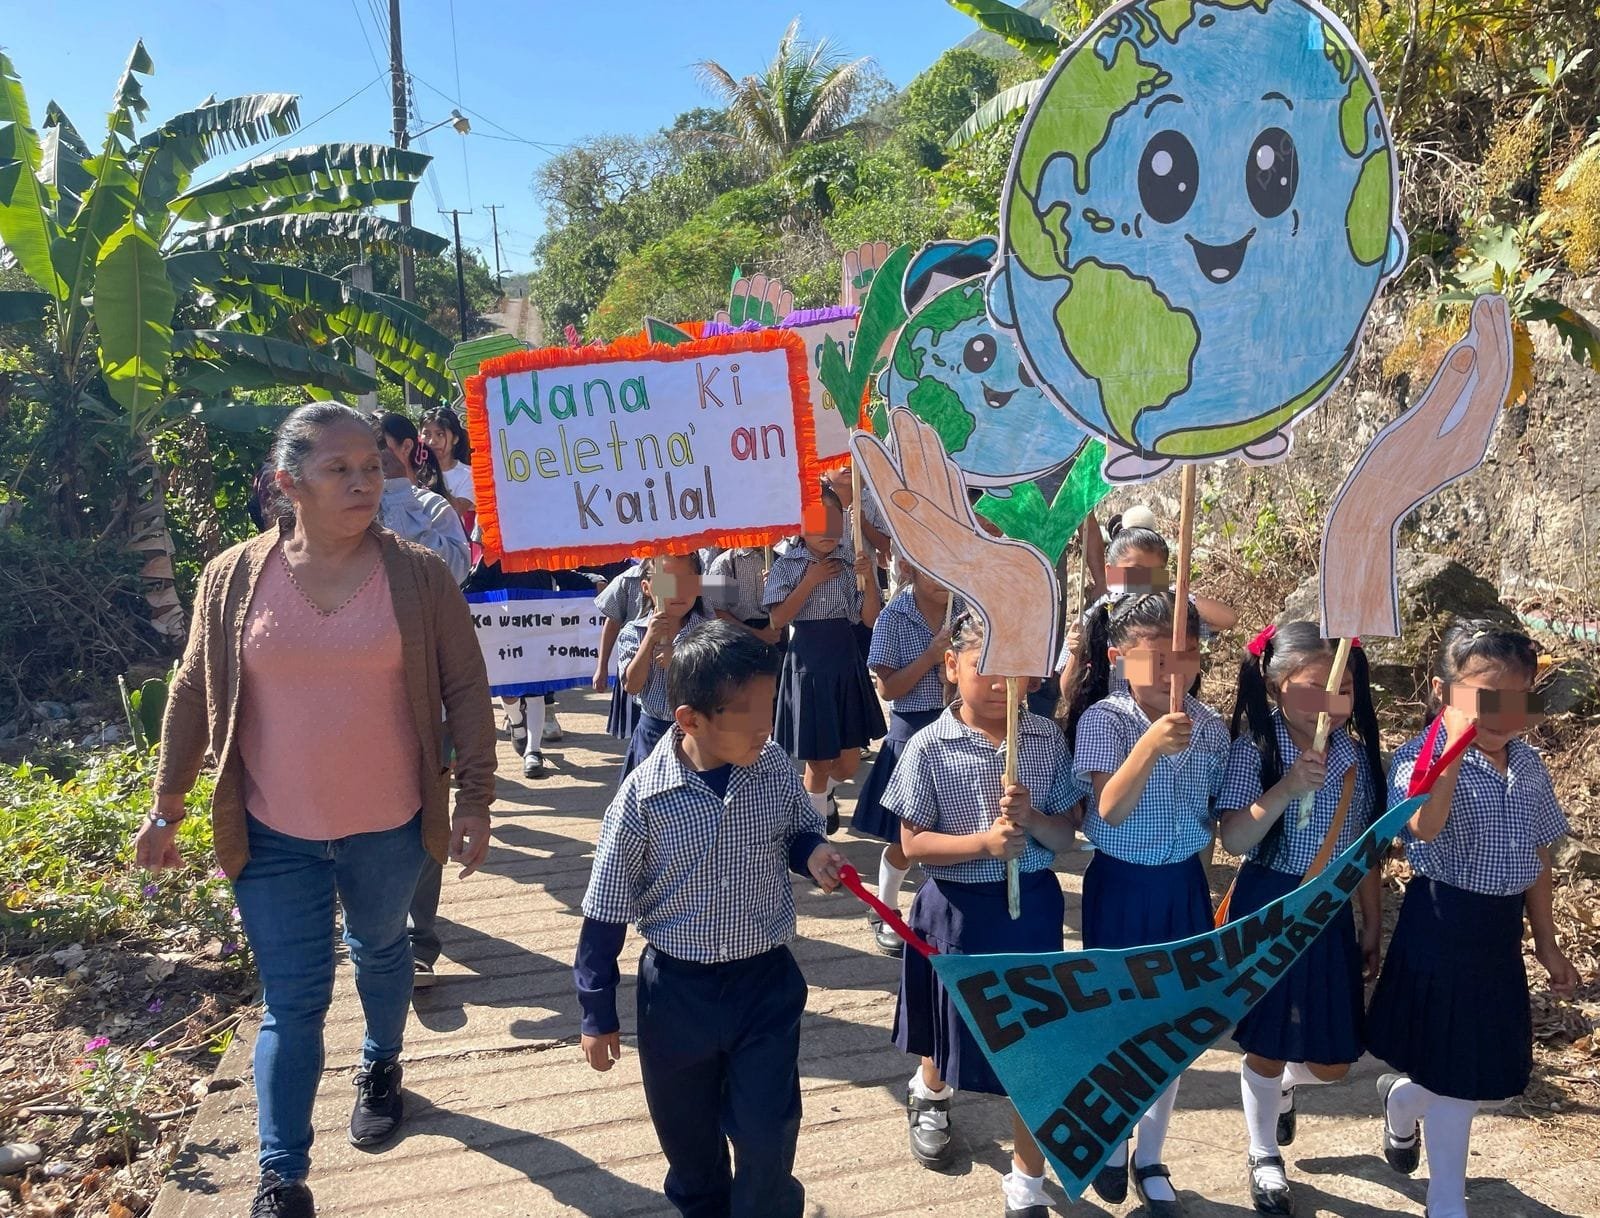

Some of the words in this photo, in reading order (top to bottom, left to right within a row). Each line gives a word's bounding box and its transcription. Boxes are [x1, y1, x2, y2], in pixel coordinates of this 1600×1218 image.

[500, 371, 651, 425] Wana
[499, 421, 696, 482] beletna'
[731, 424, 785, 460] an
[498, 644, 523, 660] tin
[1034, 1006, 1232, 1180] BENITO
[1222, 830, 1392, 1008] JUAREZ
